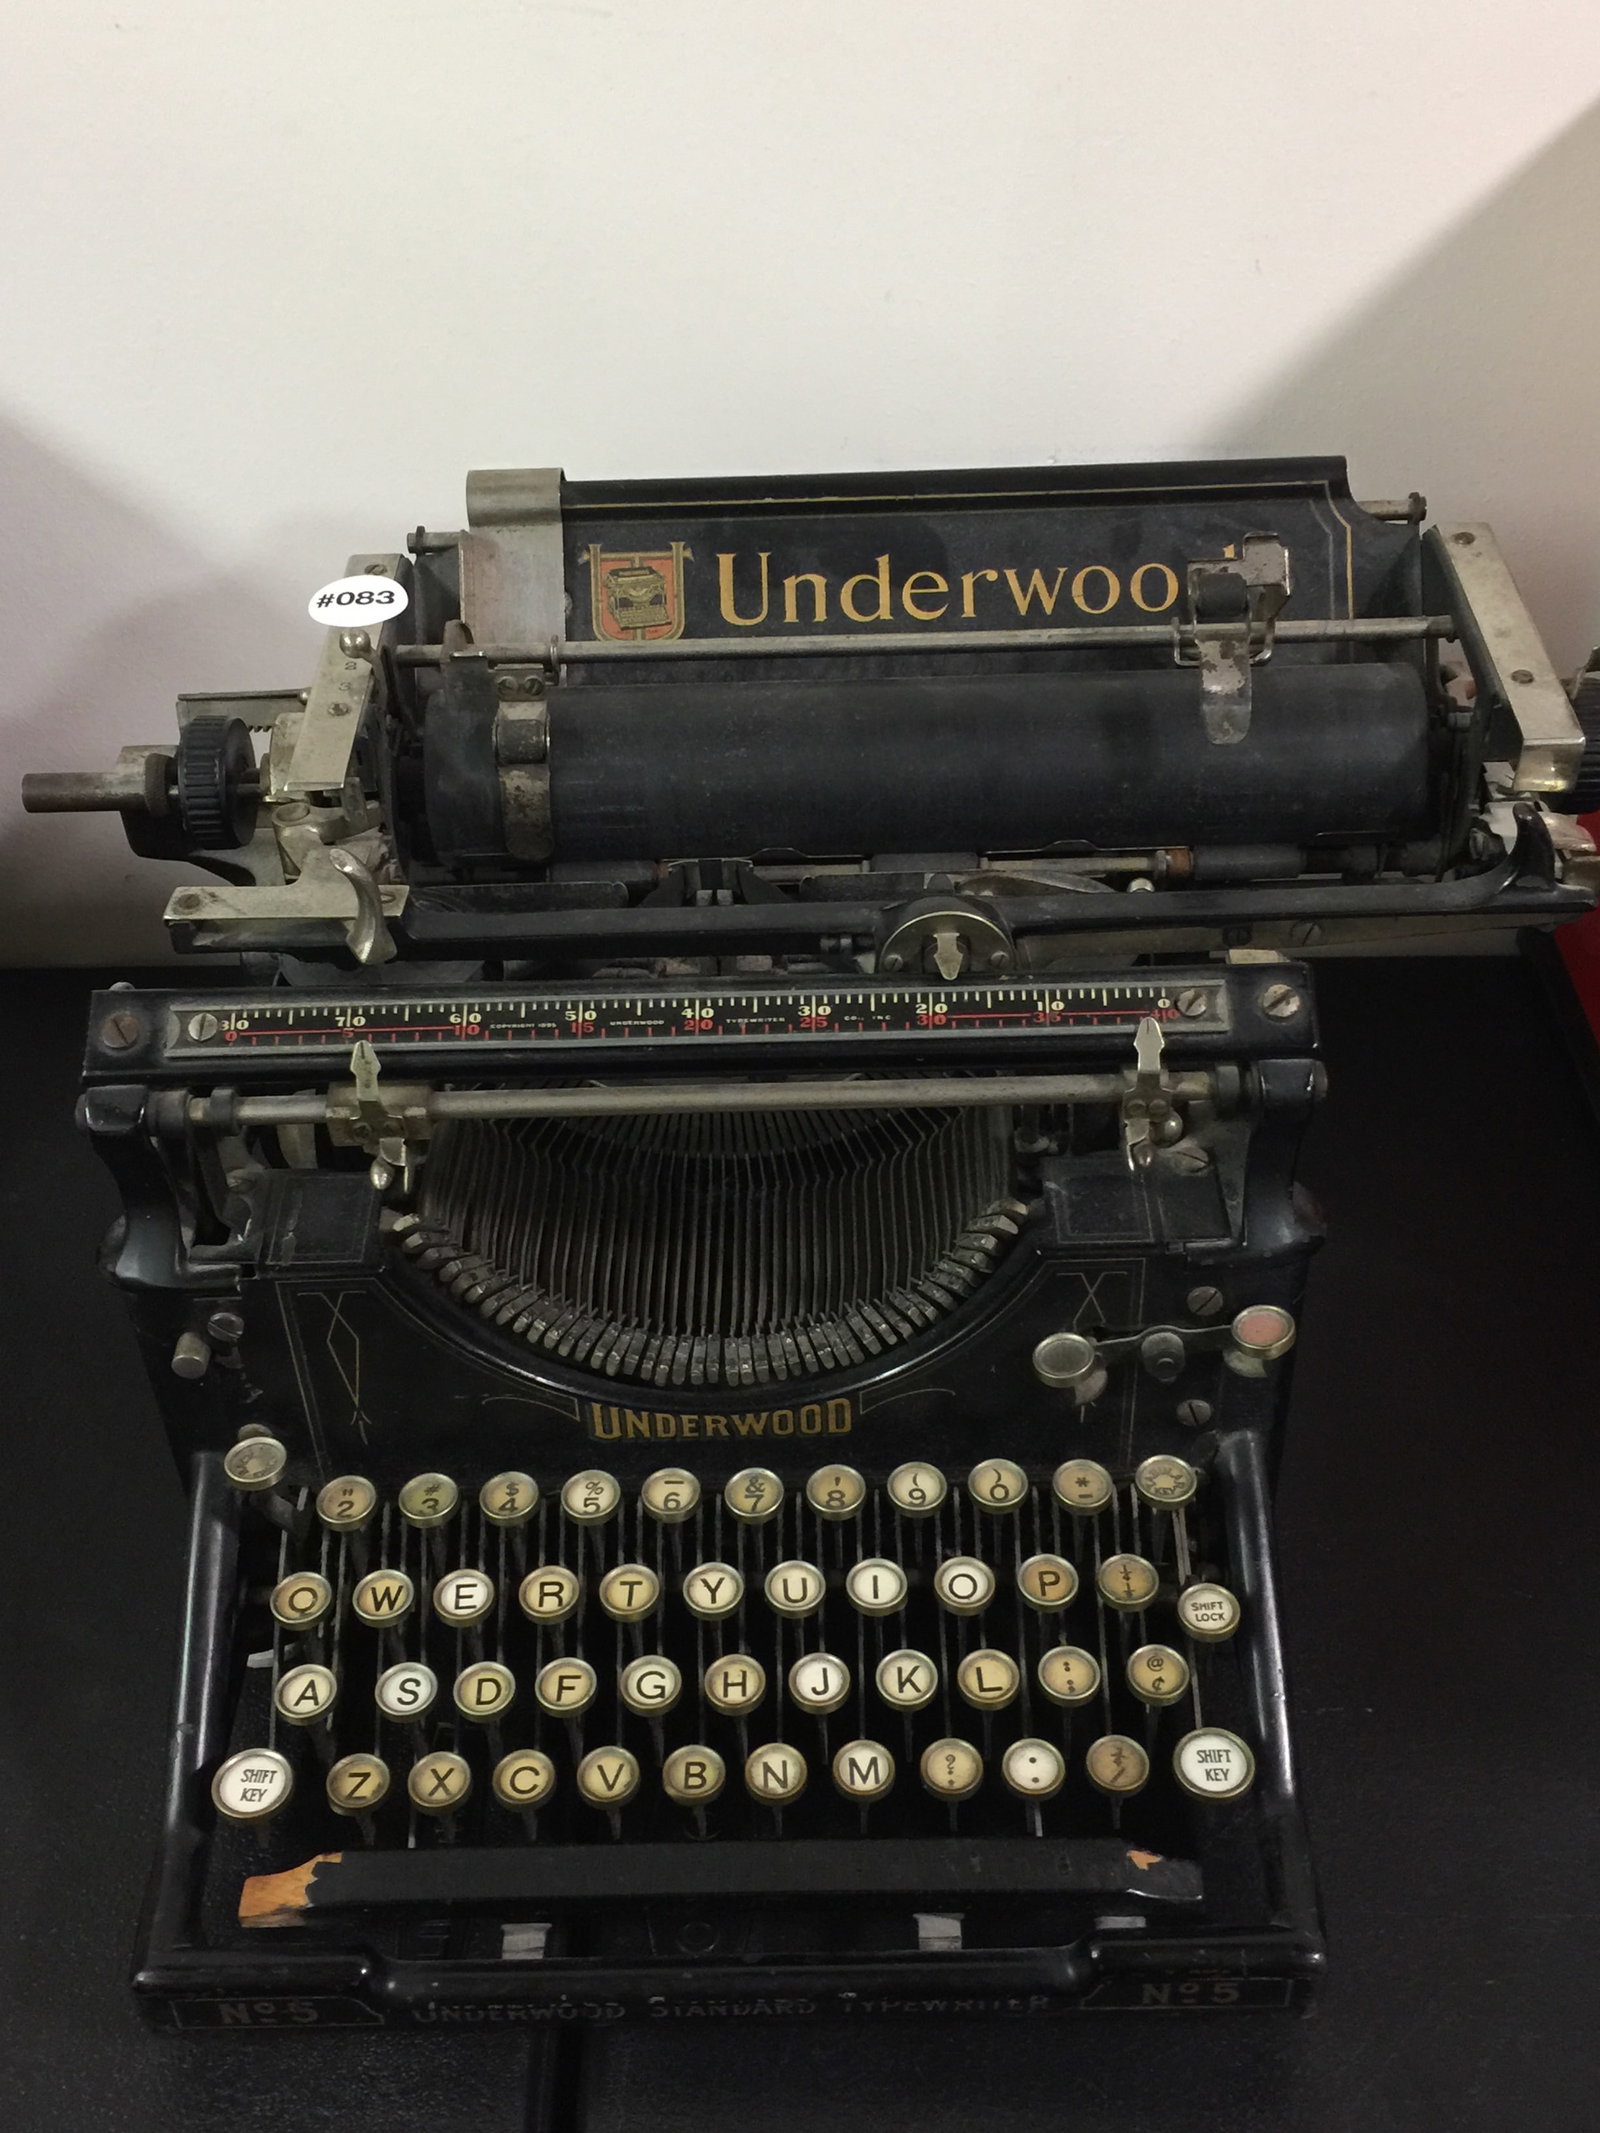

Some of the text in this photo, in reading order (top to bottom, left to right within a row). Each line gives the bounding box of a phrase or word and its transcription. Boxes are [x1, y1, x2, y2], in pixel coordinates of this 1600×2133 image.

[716, 544, 1235, 626] Underwoo
[316, 590, 396, 608] #083
[681, 1008, 714, 1018] 40
[798, 1005, 832, 1016] 30
[915, 1003, 948, 1014] 20
[1157, 998, 1171, 1009] 0
[335, 1016, 366, 1027] 70
[450, 1013, 482, 1024] 60
[565, 1010, 597, 1021] 50
[684, 1019, 713, 1031] 20
[800, 1017, 828, 1028] 25
[917, 1014, 947, 1025] 30
[1033, 1012, 1061, 1023] 35
[454, 1025, 480, 1035] 10
[571, 1022, 595, 1033] 15
[591, 1398, 852, 1440] UNDERWOOD
[420, 1498, 440, 1515] 3
[498, 1498, 518, 1513] 4
[583, 1497, 600, 1514] 5
[663, 1492, 681, 1512] 6
[744, 1494, 764, 1512] 7
[826, 1490, 845, 1508] 8
[909, 1488, 926, 1505] 9
[337, 1501, 354, 1517] 2
[619, 1580, 643, 1607] T
[700, 1577, 725, 1604] Y
[783, 1577, 807, 1603] U
[872, 1575, 879, 1599] I
[949, 1573, 977, 1599] O
[1038, 1570, 1061, 1597] P
[371, 1585, 403, 1612] W
[454, 1583, 478, 1610] E
[538, 1581, 564, 1608] R
[1191, 1601, 1224, 1612] SHIFT
[1195, 1612, 1226, 1622] LOCK
[1146, 1655, 1165, 1672] @
[555, 1674, 582, 1702] F
[636, 1670, 666, 1699] G
[723, 1669, 747, 1698] H
[811, 1667, 829, 1696] J
[897, 1665, 922, 1694] K
[976, 1666, 1003, 1693] L
[293, 1679, 319, 1707] A
[397, 1677, 421, 1705] S
[475, 1677, 500, 1706] D
[1197, 1750, 1232, 1763] SHIFT
[240, 1769, 277, 1784] SHIFT
[509, 1765, 540, 1795] C
[597, 1763, 625, 1792] V
[684, 1761, 707, 1790] B
[762, 1760, 788, 1789] N
[848, 1756, 881, 1786] M
[1206, 1768, 1229, 1782] KEY
[346, 1772, 372, 1799] Z
[428, 1767, 455, 1797] X
[239, 1788, 268, 1803] KEY
[1213, 1982, 1240, 2004] 5
[289, 2002, 319, 2023] 5
[413, 2002, 626, 2022] UNDERWOOD
